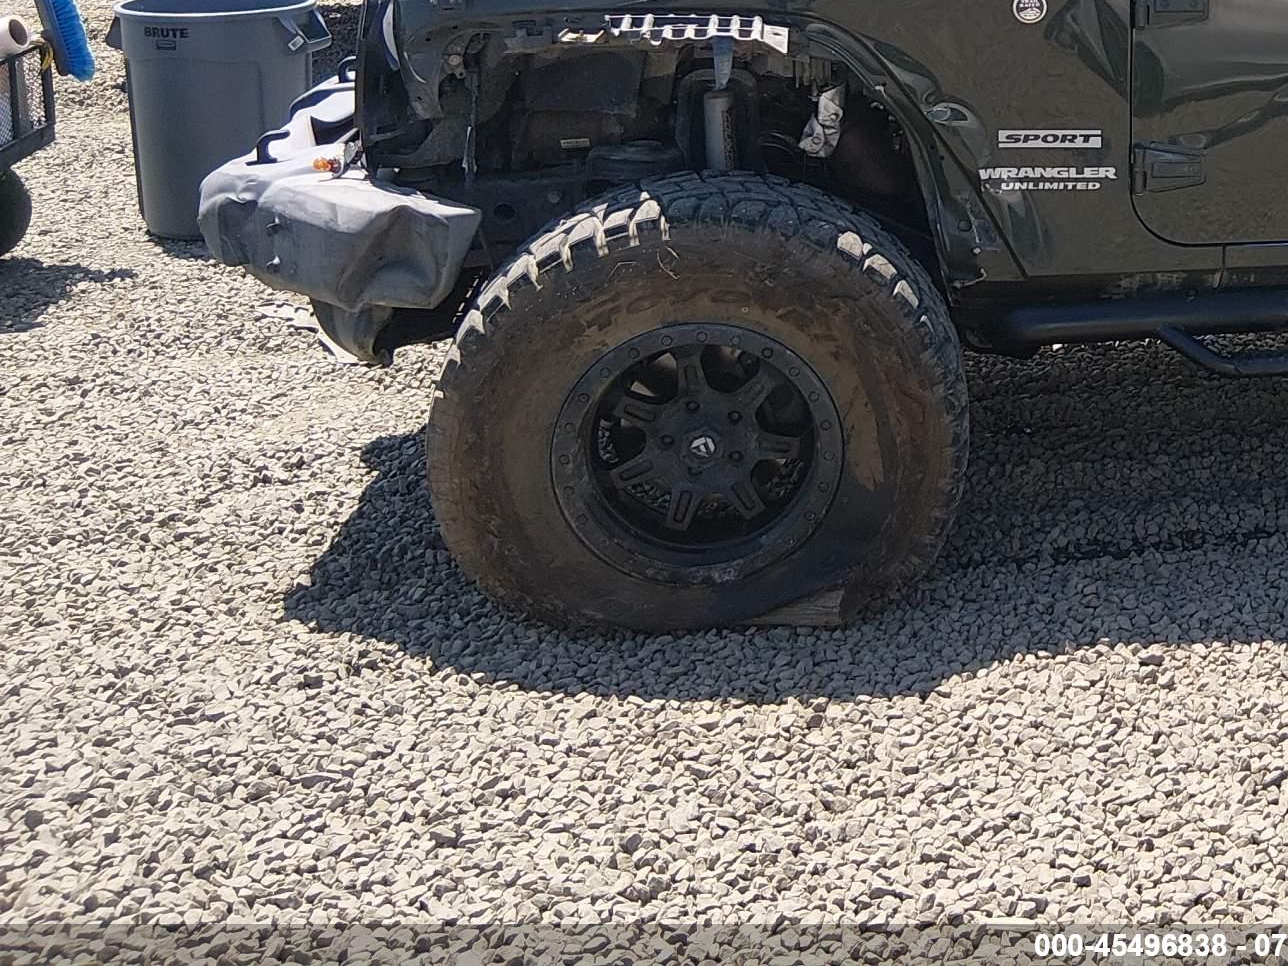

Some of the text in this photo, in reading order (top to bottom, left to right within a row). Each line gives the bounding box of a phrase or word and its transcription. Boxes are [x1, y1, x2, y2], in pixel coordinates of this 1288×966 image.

[144, 26, 190, 39] BRUTE
[1000, 133, 1102, 145] SPORT
[978, 166, 1118, 181] WRANGLER
[1001, 181, 1101, 191] UNLIMITED
